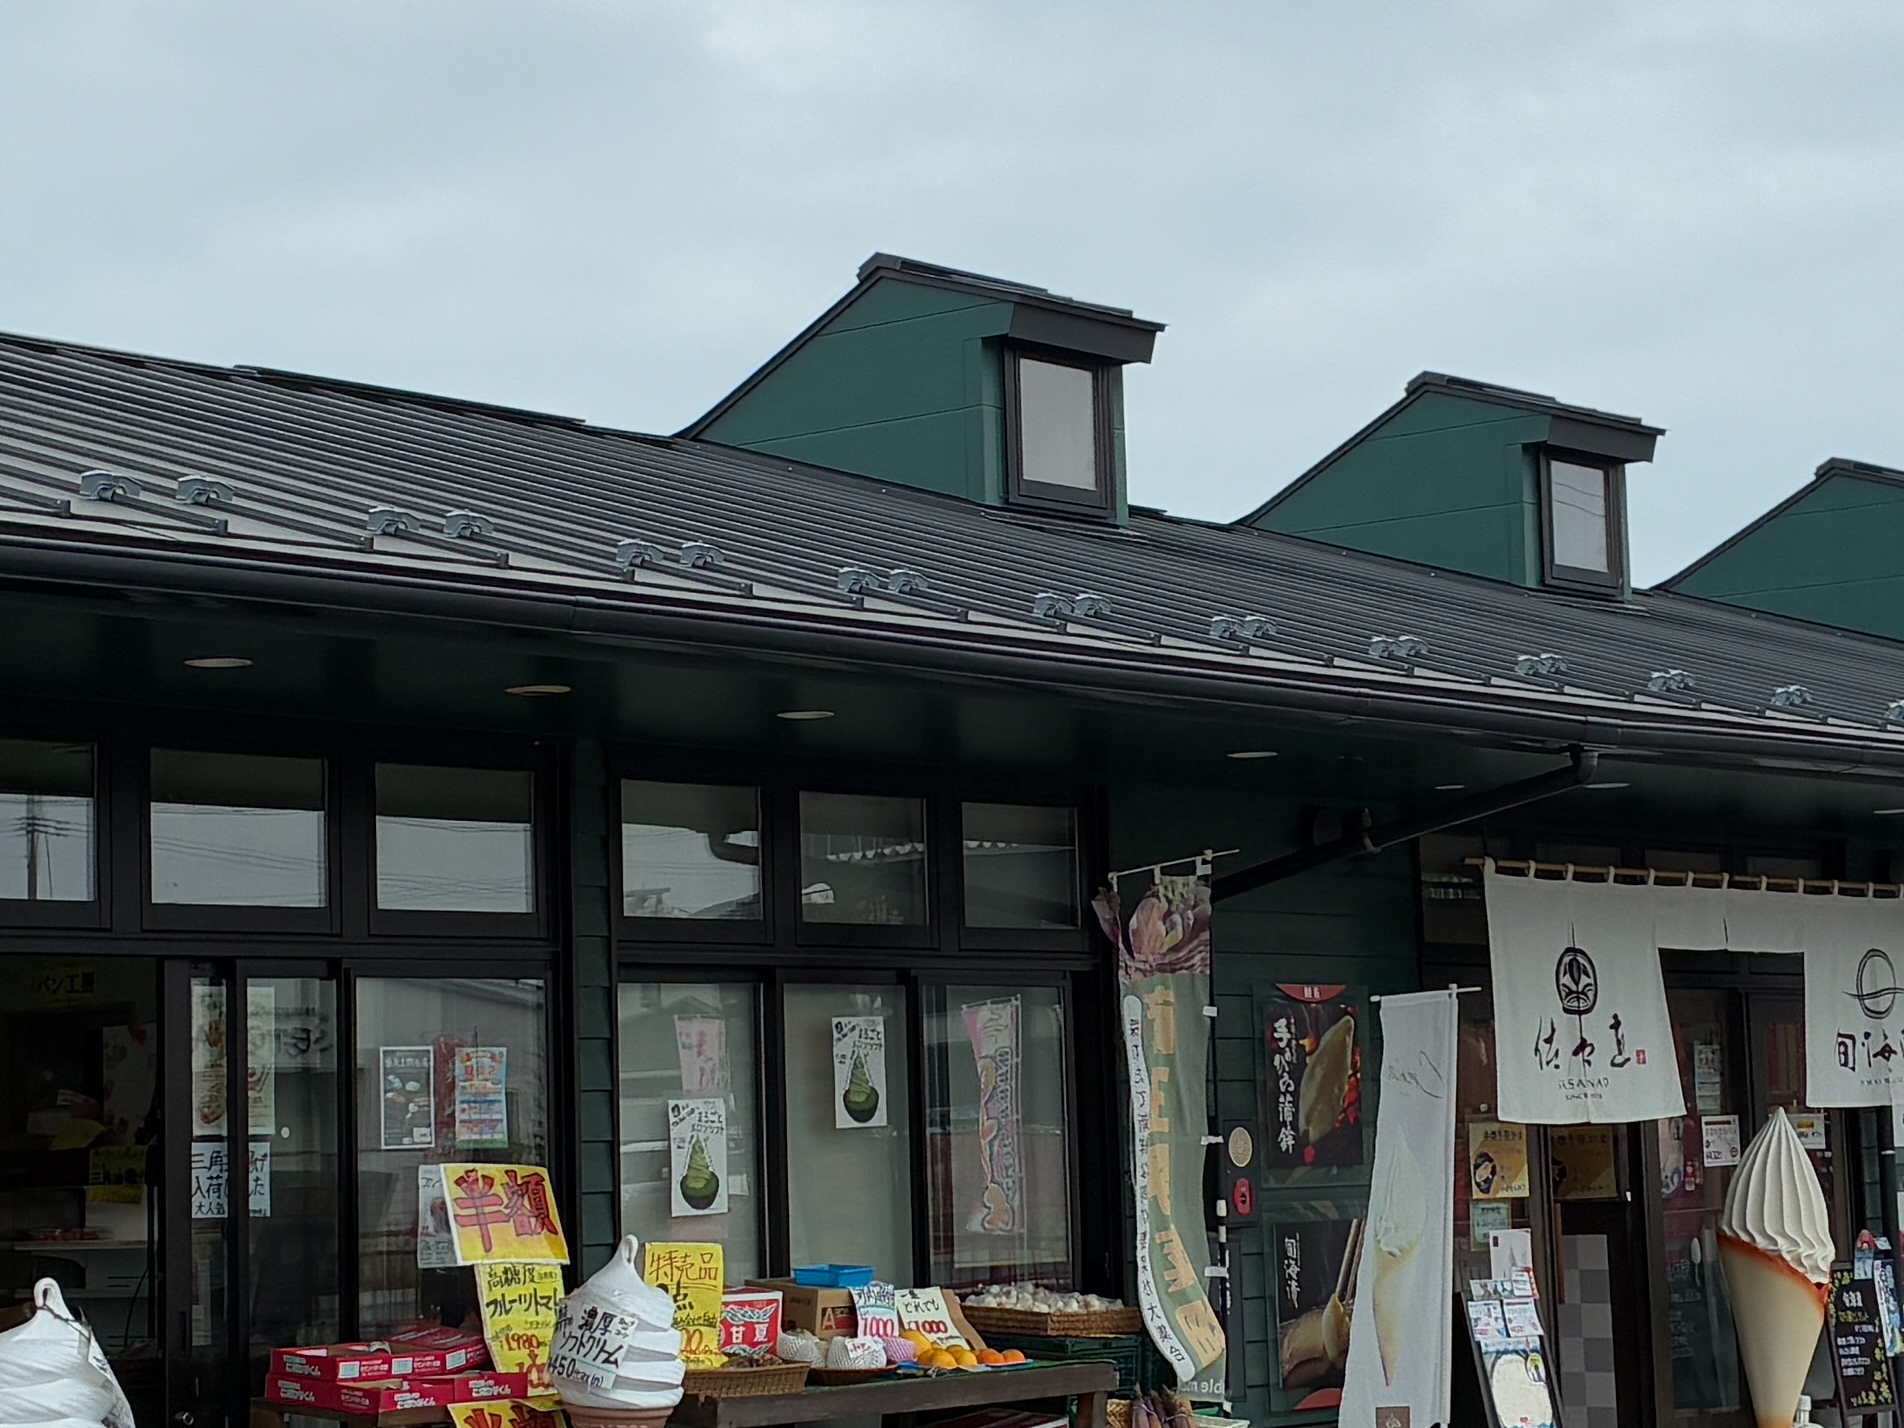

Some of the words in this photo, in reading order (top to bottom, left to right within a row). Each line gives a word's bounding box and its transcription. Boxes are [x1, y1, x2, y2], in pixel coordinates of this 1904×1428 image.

[453, 1167, 560, 1254] 半額
[650, 1250, 719, 1283] 特売品
[577, 1306, 618, 1337] 濃厚
[730, 1323, 770, 1343] 甘夏
[559, 1330, 625, 1370] ソフトクリーム
